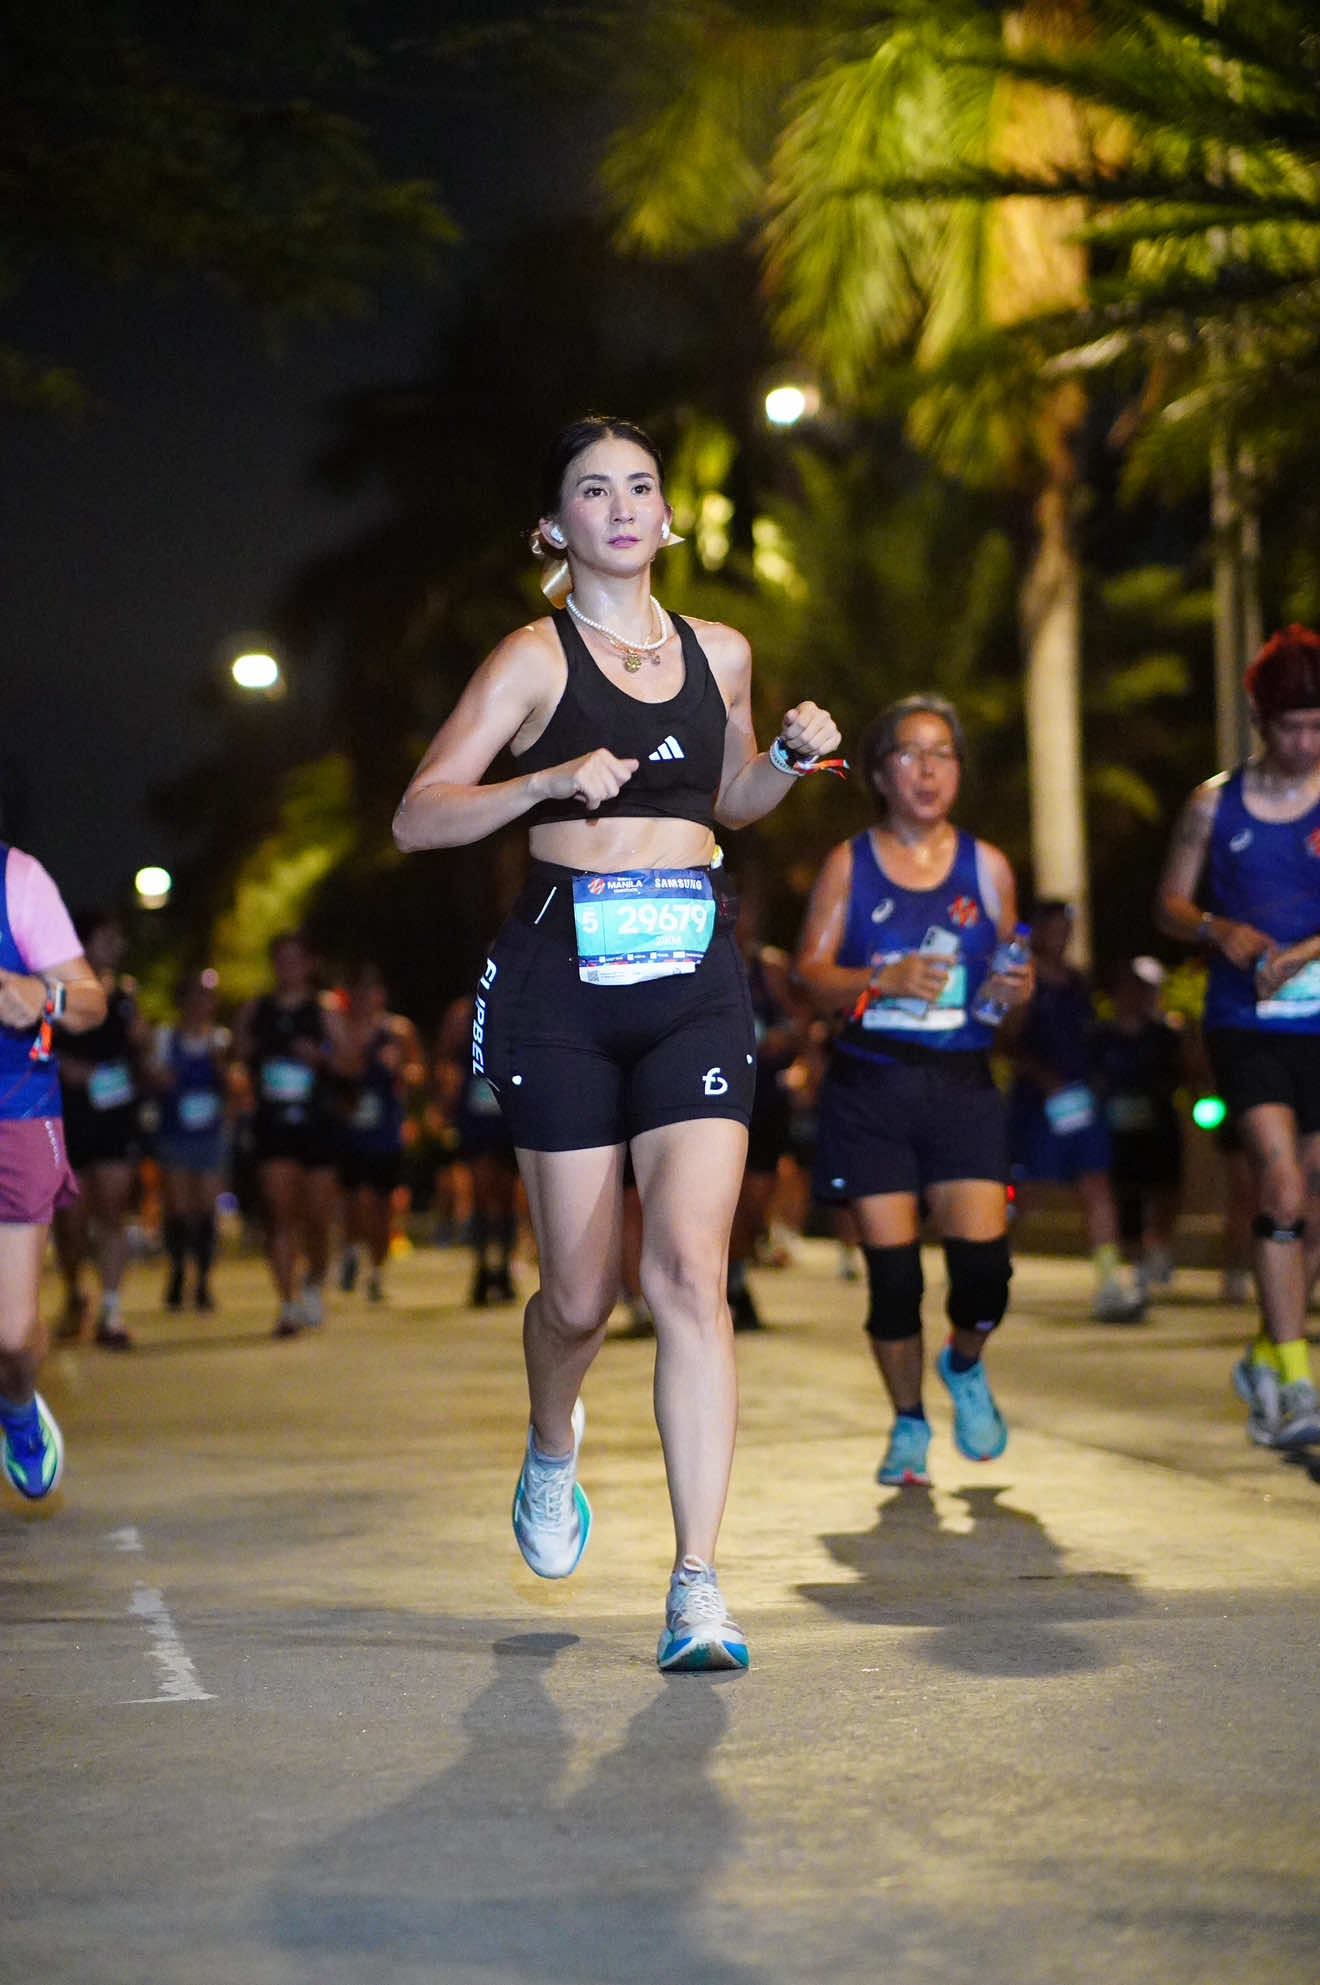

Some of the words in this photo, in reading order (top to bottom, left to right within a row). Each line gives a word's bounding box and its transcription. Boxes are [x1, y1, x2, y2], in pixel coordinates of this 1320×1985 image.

[607, 880, 643, 889] MANILA
[654, 878, 703, 890] SAMSUNG
[582, 906, 599, 933] 5
[616, 903, 707, 934] 29679
